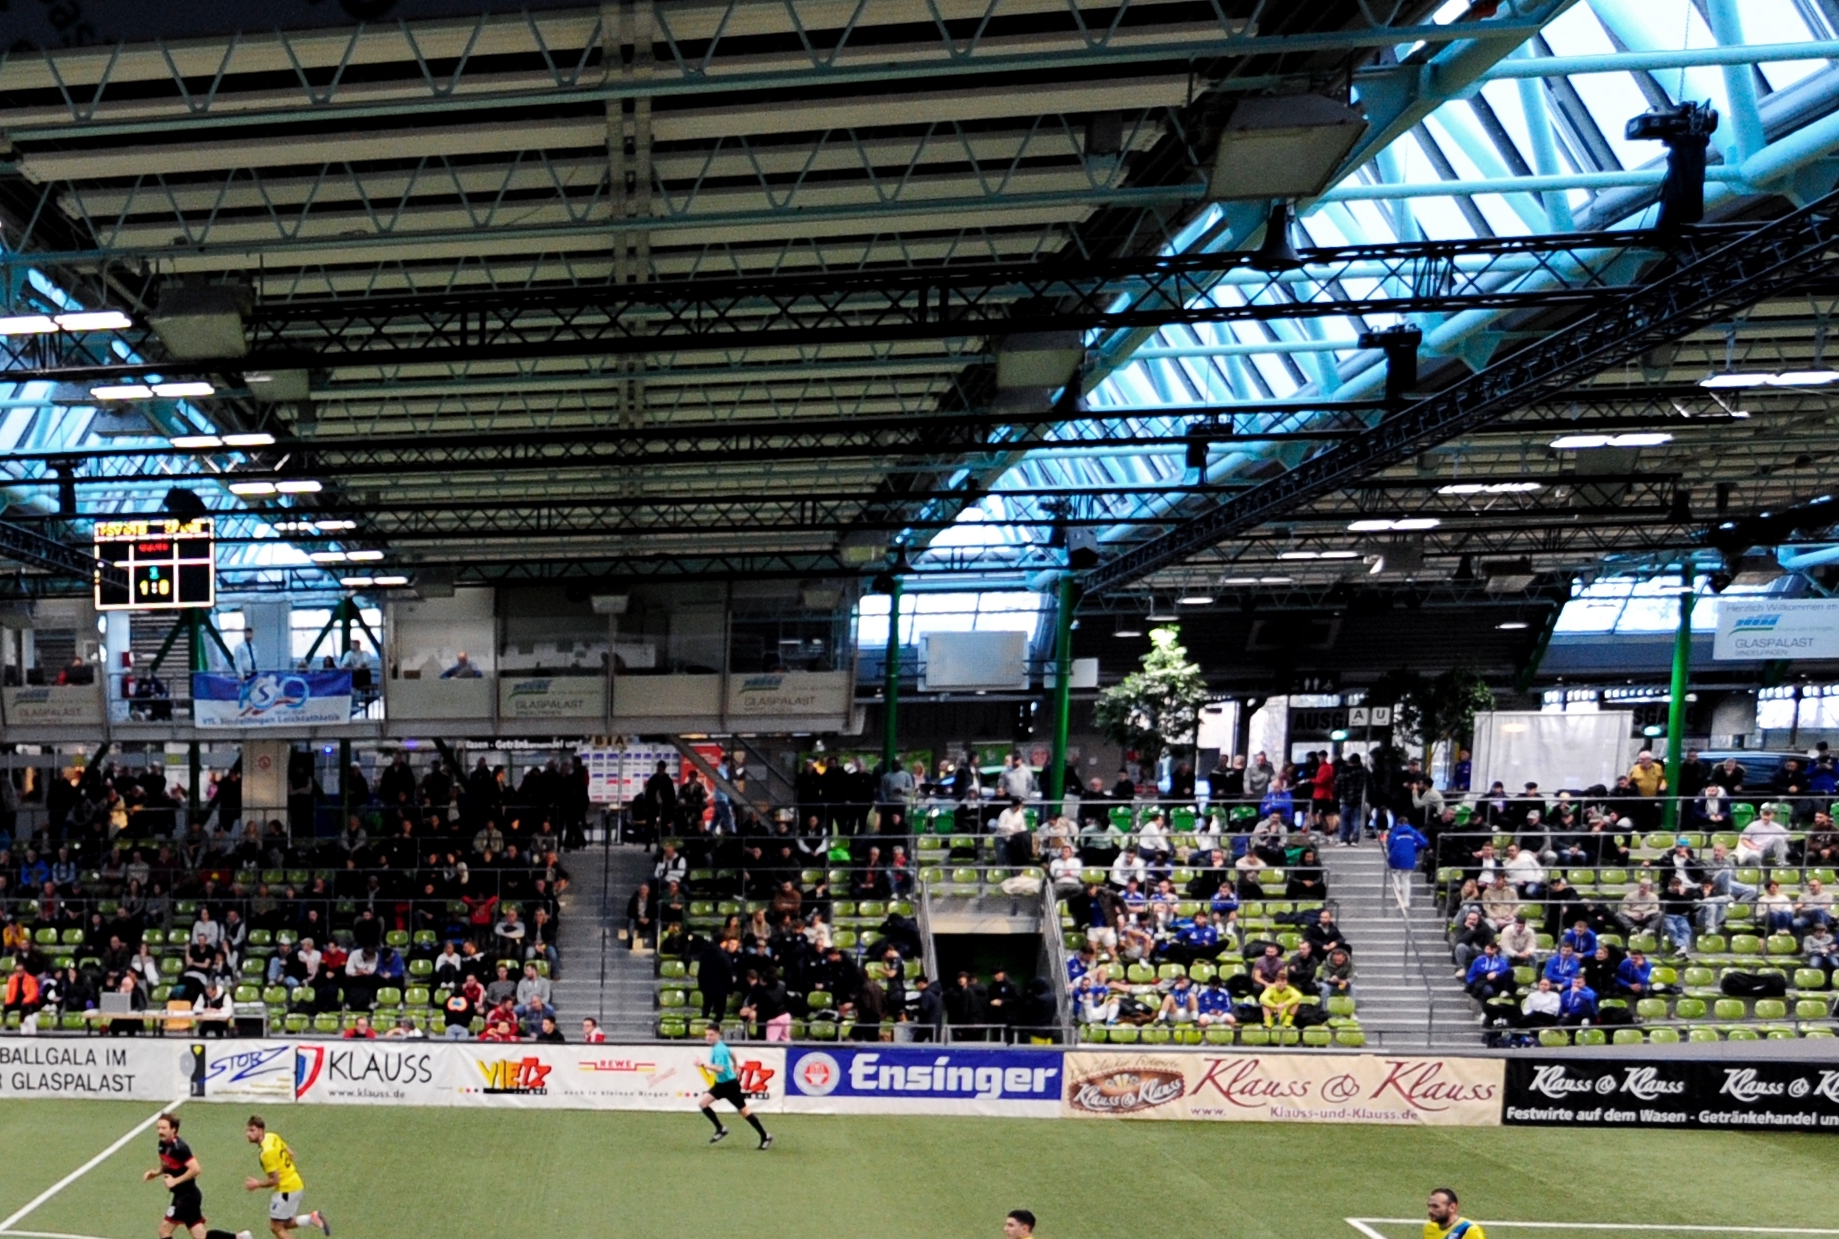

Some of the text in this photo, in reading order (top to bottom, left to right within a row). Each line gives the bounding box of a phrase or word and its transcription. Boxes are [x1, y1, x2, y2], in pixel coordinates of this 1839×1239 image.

[1766, 603, 1823, 612] Willkommen
[1735, 638, 1814, 648] GLASPALAST
[1353, 710, 1364, 719] A
[1377, 710, 1385, 719] U
[106, 1048, 127, 1066] IM
[600, 1060, 632, 1068] REWE
[328, 1050, 433, 1084] KLAUSS
[477, 1056, 551, 1090] VIETZ
[848, 1053, 1058, 1100] Ensinger
[12, 1072, 136, 1092] GLASPALAST
[1188, 1058, 1312, 1108] Klauss
[1321, 1073, 1360, 1103] &
[1369, 1060, 1496, 1112] Klauss
[1529, 1065, 1591, 1099] Klauss
[1620, 1066, 1685, 1100] Klauss
[1719, 1068, 1784, 1101] Klauss
[328, 1088, 406, 1099] www.klauss.de
[1191, 1106, 1418, 1121] www. Klauss-und-Klauss.de
[1507, 1106, 1574, 1121] Festwirte
[1576, 1107, 1602, 1121] auf
[1604, 1108, 1636, 1122] dem
[1639, 1109, 1686, 1123] Wasen
[1699, 1109, 1817, 1126] Getränkehandel
[1820, 1115, 1839, 1126] un
